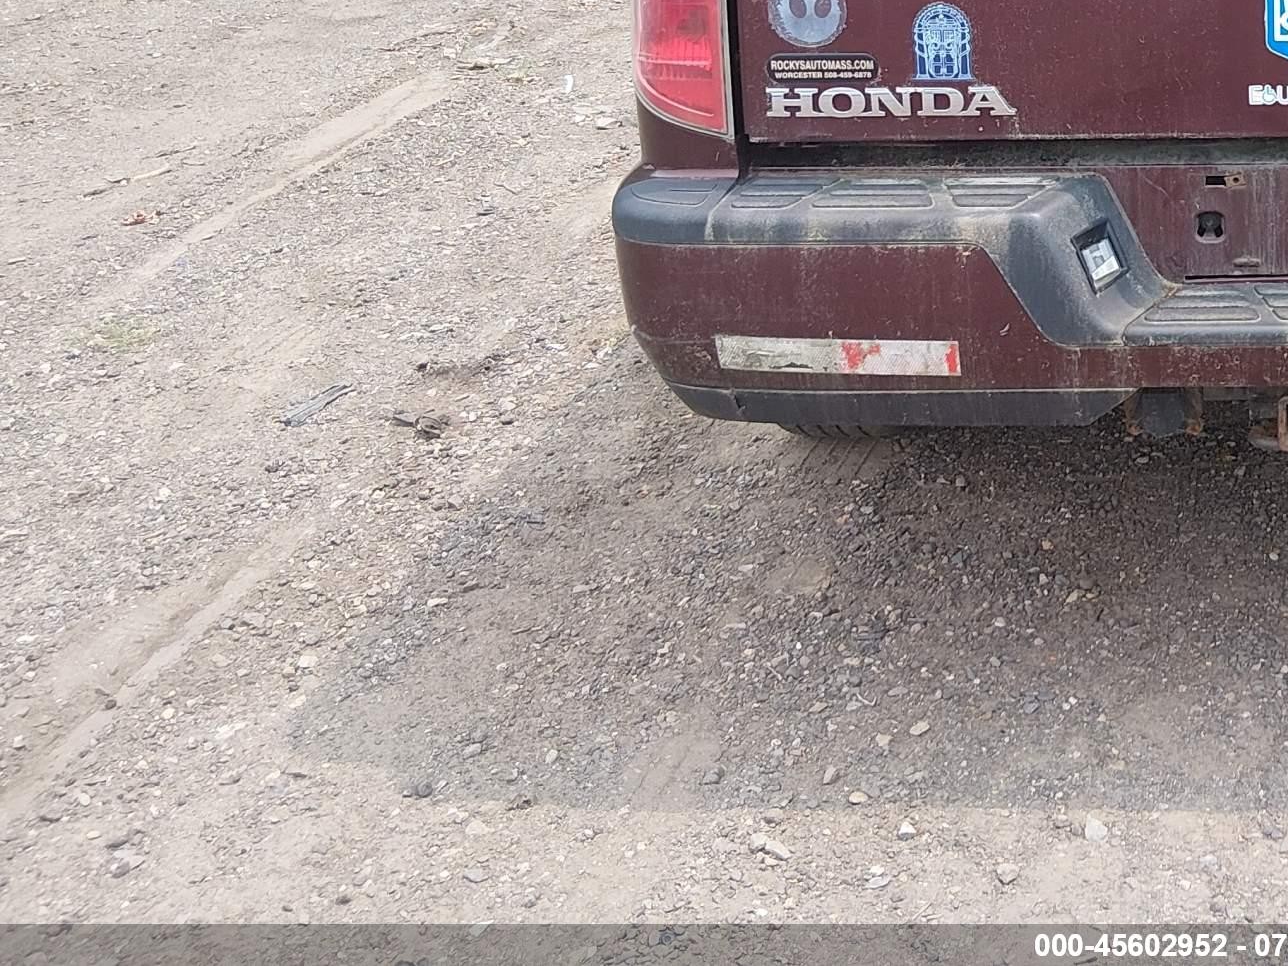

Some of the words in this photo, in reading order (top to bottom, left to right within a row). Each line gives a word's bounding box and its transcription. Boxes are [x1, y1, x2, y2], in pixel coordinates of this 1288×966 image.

[770, 60, 875, 71] ROCKYSAUTOMASS.COM
[774, 71, 823, 79] WORCESTER
[765, 86, 1017, 118] HONDA
